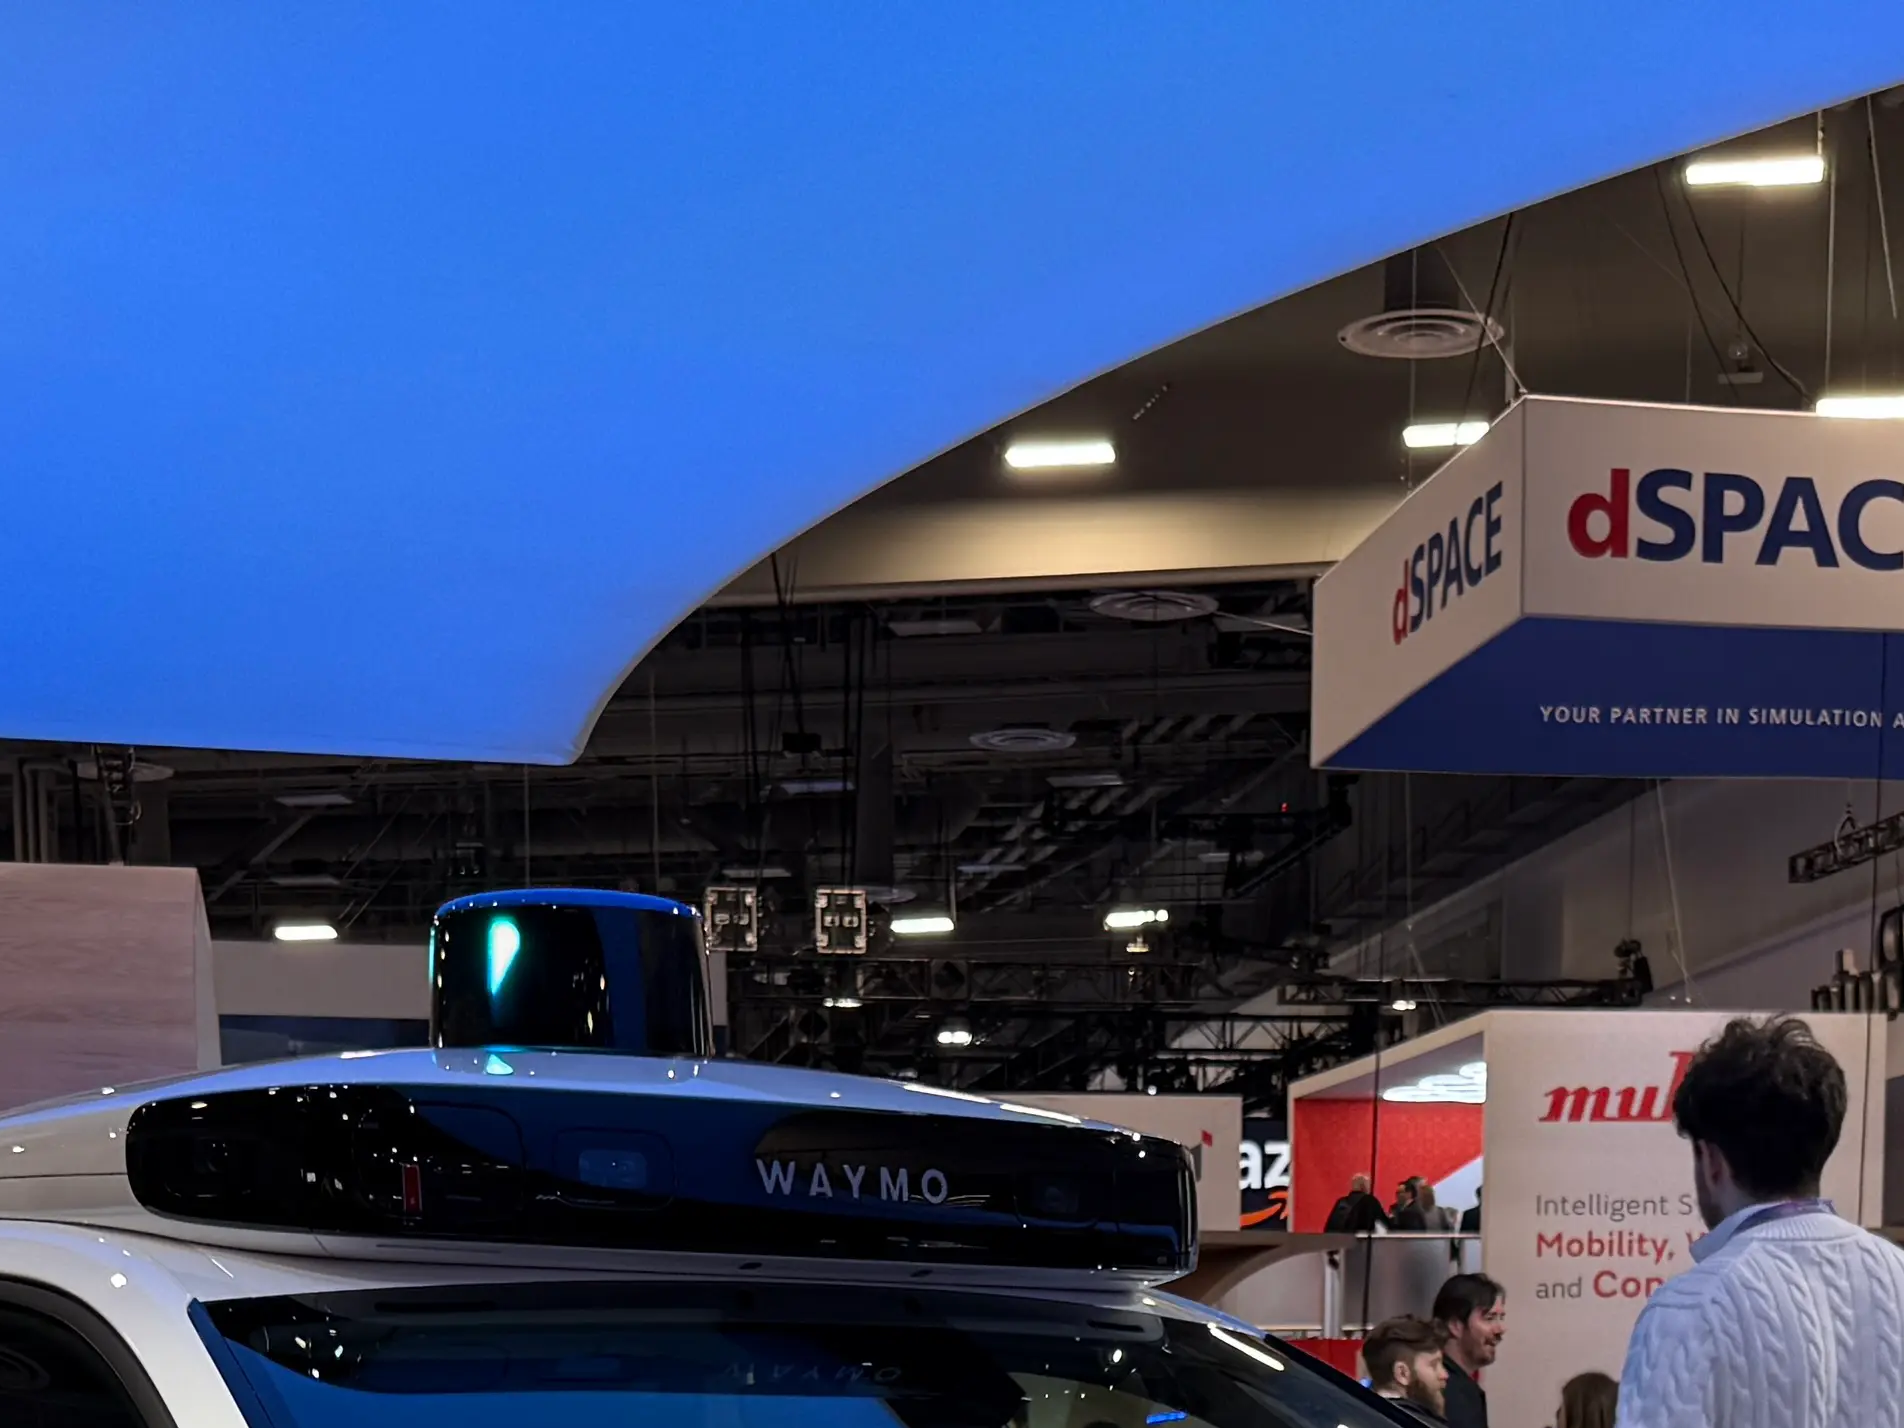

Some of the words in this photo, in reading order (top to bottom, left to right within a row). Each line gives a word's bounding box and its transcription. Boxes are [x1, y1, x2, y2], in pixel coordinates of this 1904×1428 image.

[1393, 481, 1504, 645] dSPACE
[1540, 705, 1601, 725] YOUR
[1609, 706, 1708, 726] PARTNER
[1717, 708, 1740, 725] IN
[1749, 708, 1882, 729] SIMULATION
[756, 1158, 948, 1204] WAYMO
[1535, 1192, 1670, 1222] Intelligent
[1535, 1229, 1677, 1265] Mobility,
[1535, 1276, 1583, 1300] and
